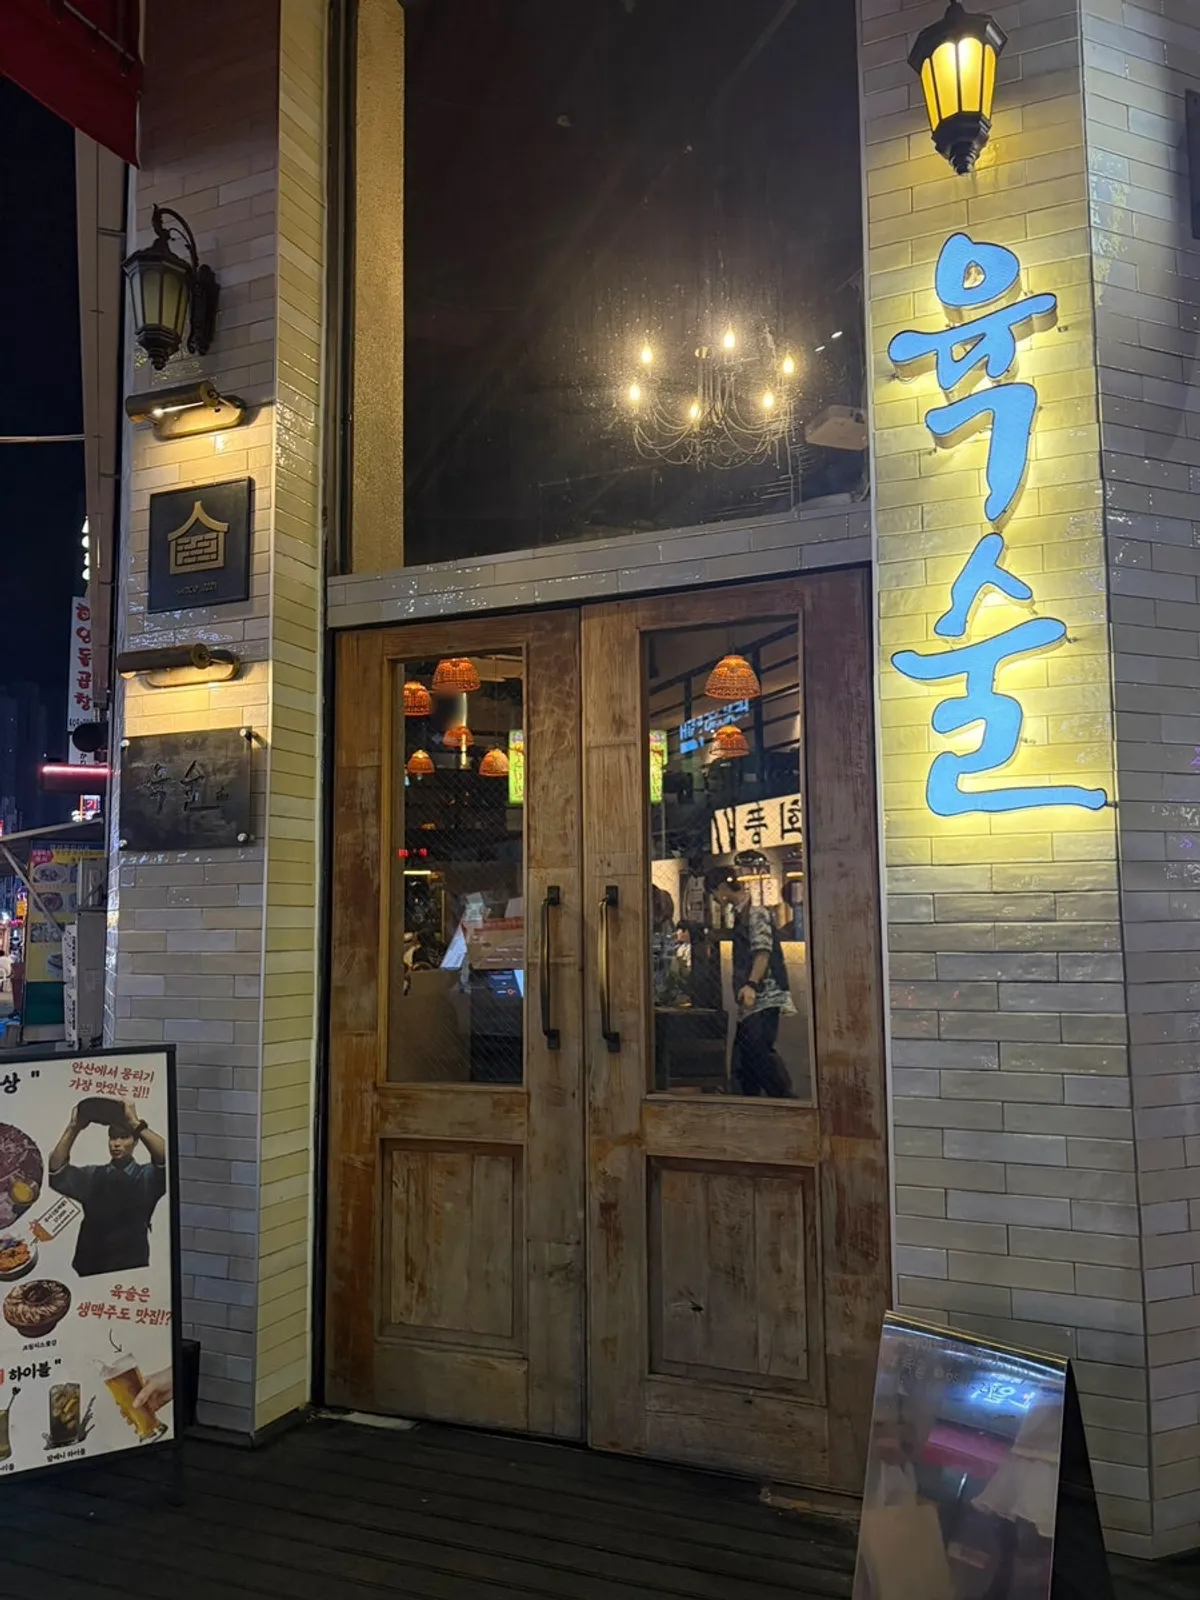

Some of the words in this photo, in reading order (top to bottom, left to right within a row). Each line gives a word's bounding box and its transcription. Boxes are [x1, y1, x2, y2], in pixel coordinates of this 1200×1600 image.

[888, 231, 1108, 817] 육술
[72, 1061, 118, 1079] 안산에서
[69, 1077, 92, 1092] 가장
[95, 1081, 129, 1097] 맛있는
[76, 1301, 131, 1320] 생맥주도
